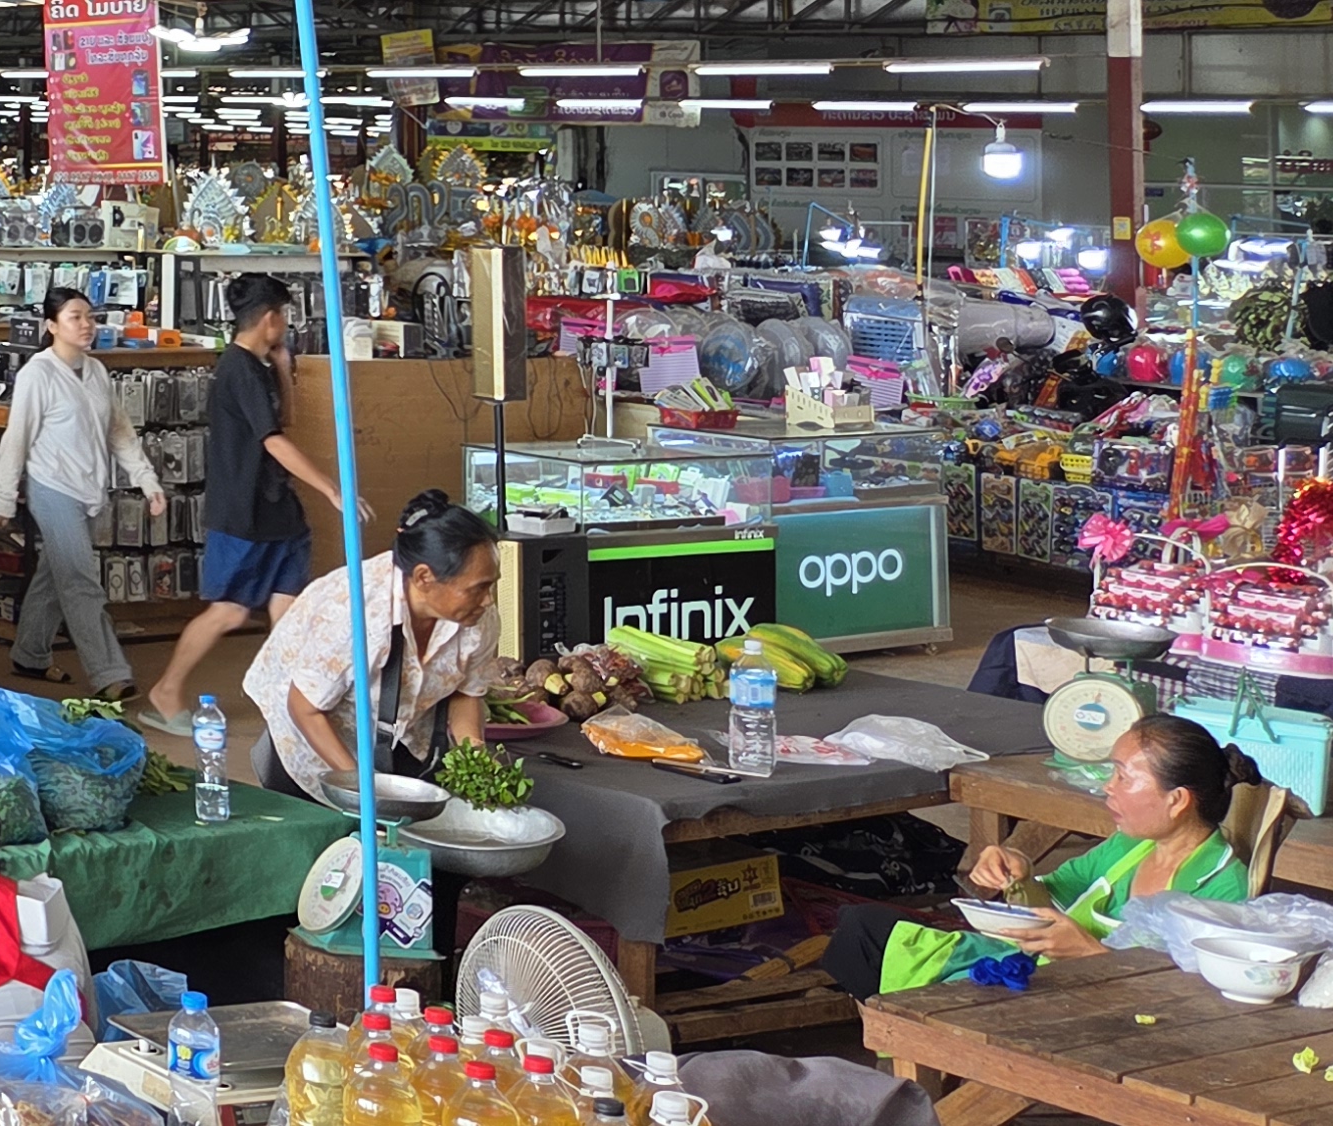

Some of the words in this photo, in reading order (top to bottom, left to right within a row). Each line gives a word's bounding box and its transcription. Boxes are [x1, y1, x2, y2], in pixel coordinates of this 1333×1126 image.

[734, 527, 766, 540] Infinix
[798, 548, 904, 597] oppo
[603, 584, 756, 642] Infinix
